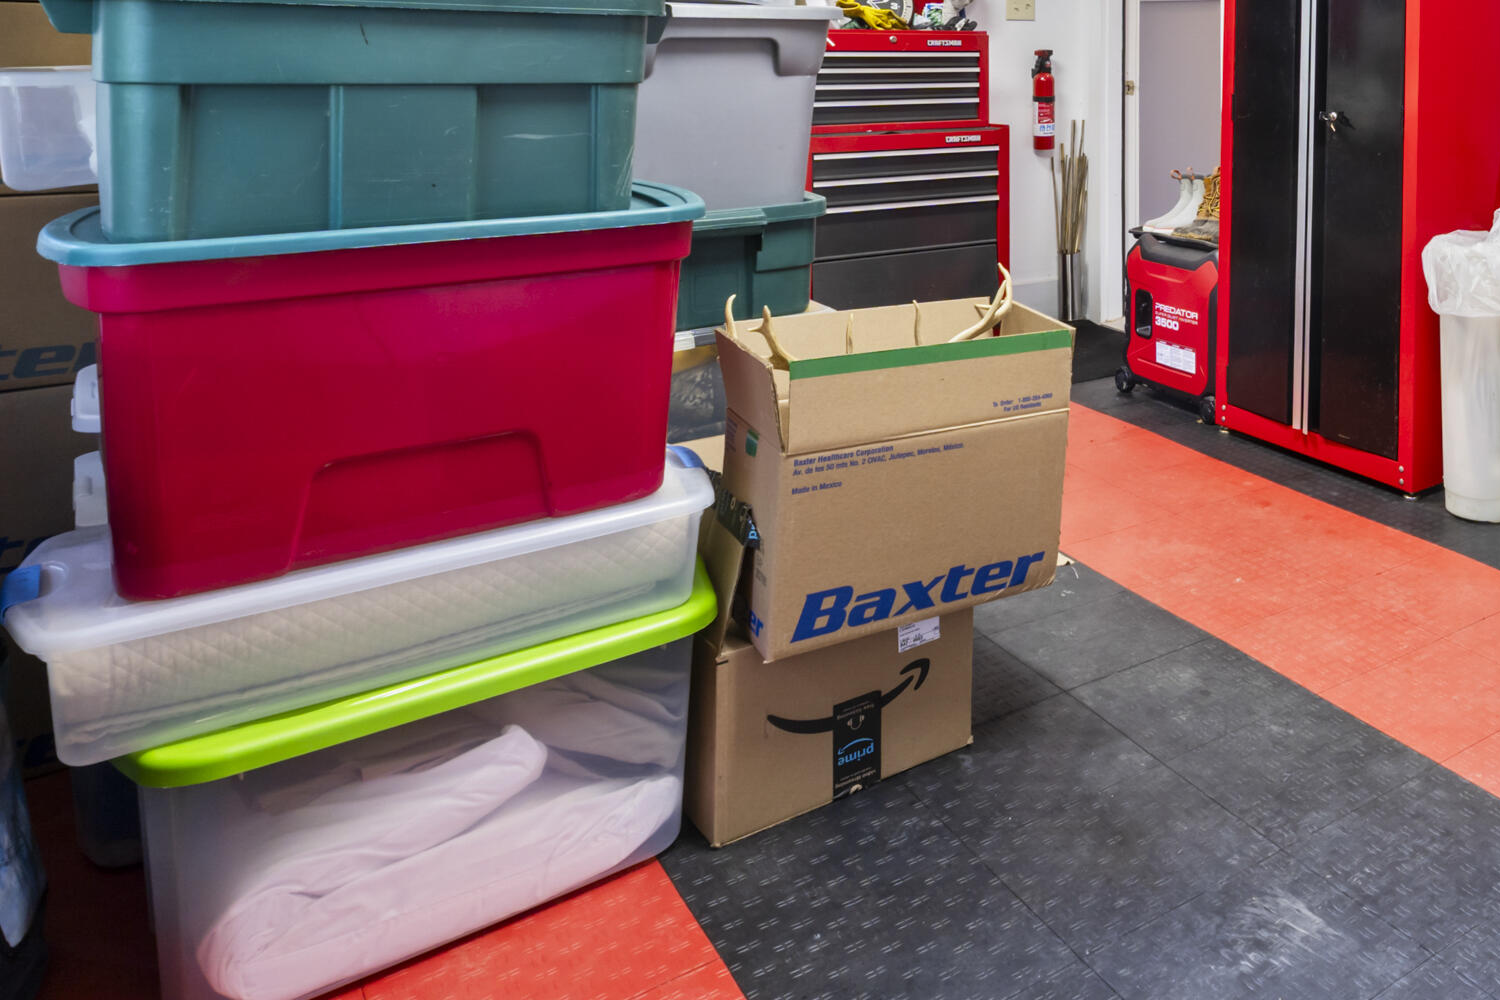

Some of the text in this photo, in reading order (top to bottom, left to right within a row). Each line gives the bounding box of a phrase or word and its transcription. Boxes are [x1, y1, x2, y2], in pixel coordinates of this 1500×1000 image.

[1154, 302, 1199, 321] PREDATOR
[1154, 315, 1179, 332] 3500
[793, 444, 895, 468] Baxter Healthcare Corporation
[791, 485, 811, 496] Made
[811, 483, 818, 492] in
[790, 550, 1046, 644] Baxter
[837, 742, 875, 767] prime
